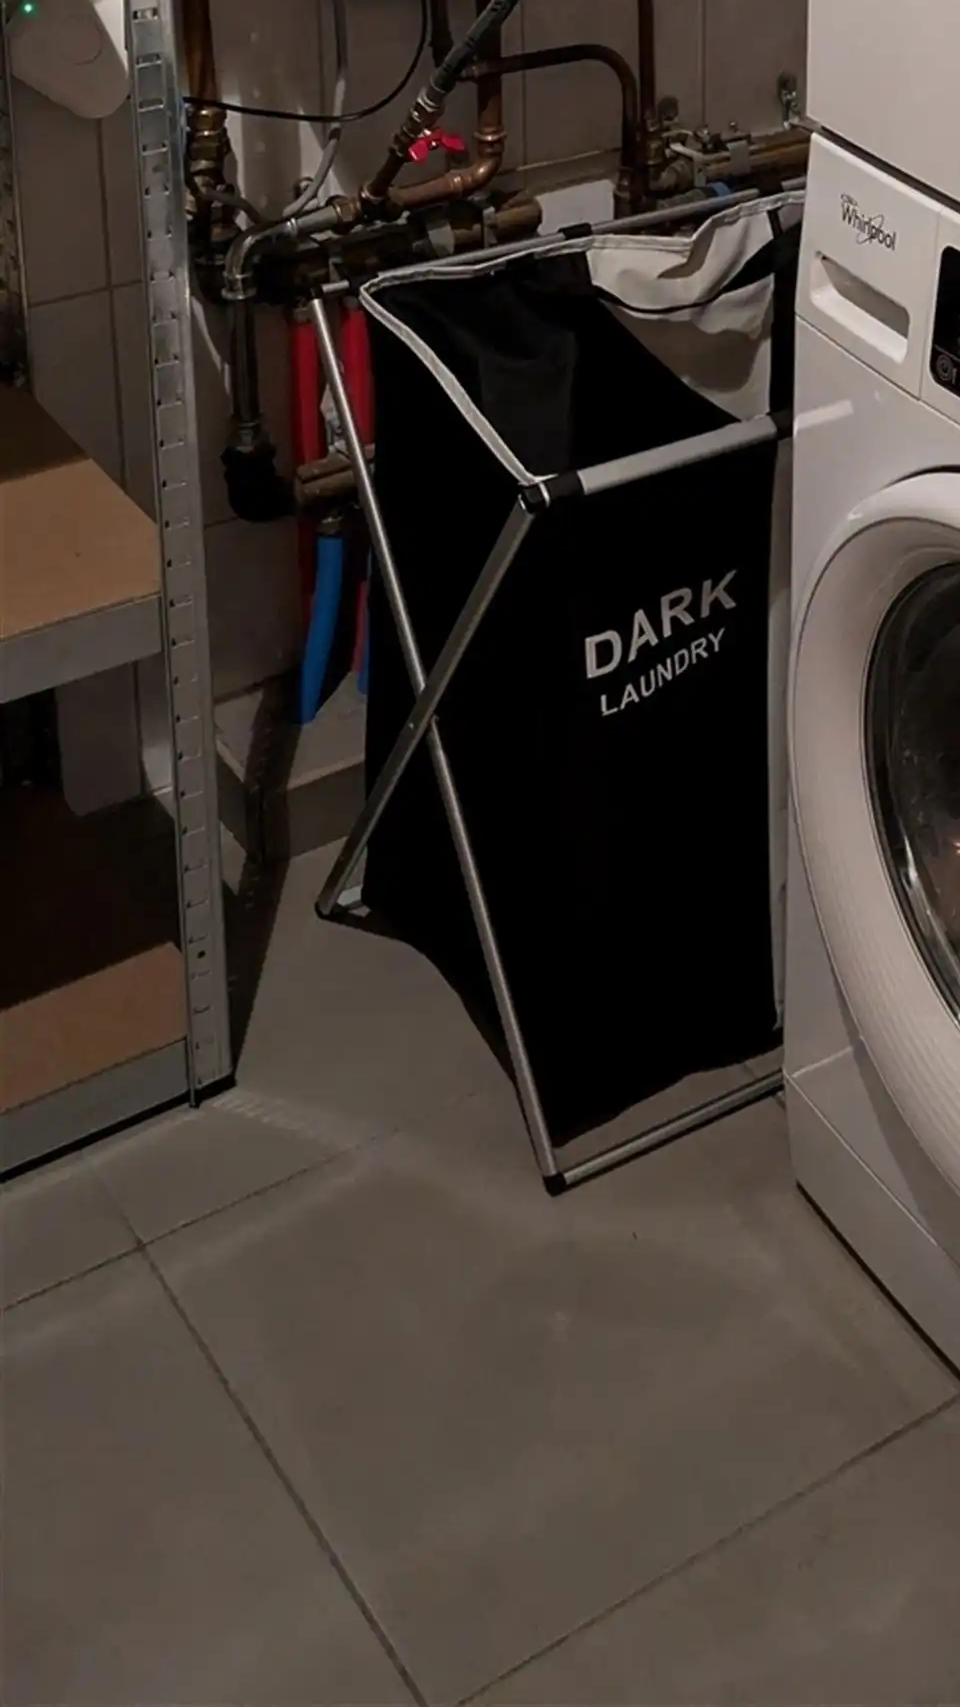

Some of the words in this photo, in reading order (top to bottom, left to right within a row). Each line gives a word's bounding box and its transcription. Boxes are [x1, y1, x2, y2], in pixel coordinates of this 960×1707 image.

[840, 201, 897, 252] Whirlpool
[584, 569, 738, 680] DARK
[600, 626, 726, 717] LAUNDRY
